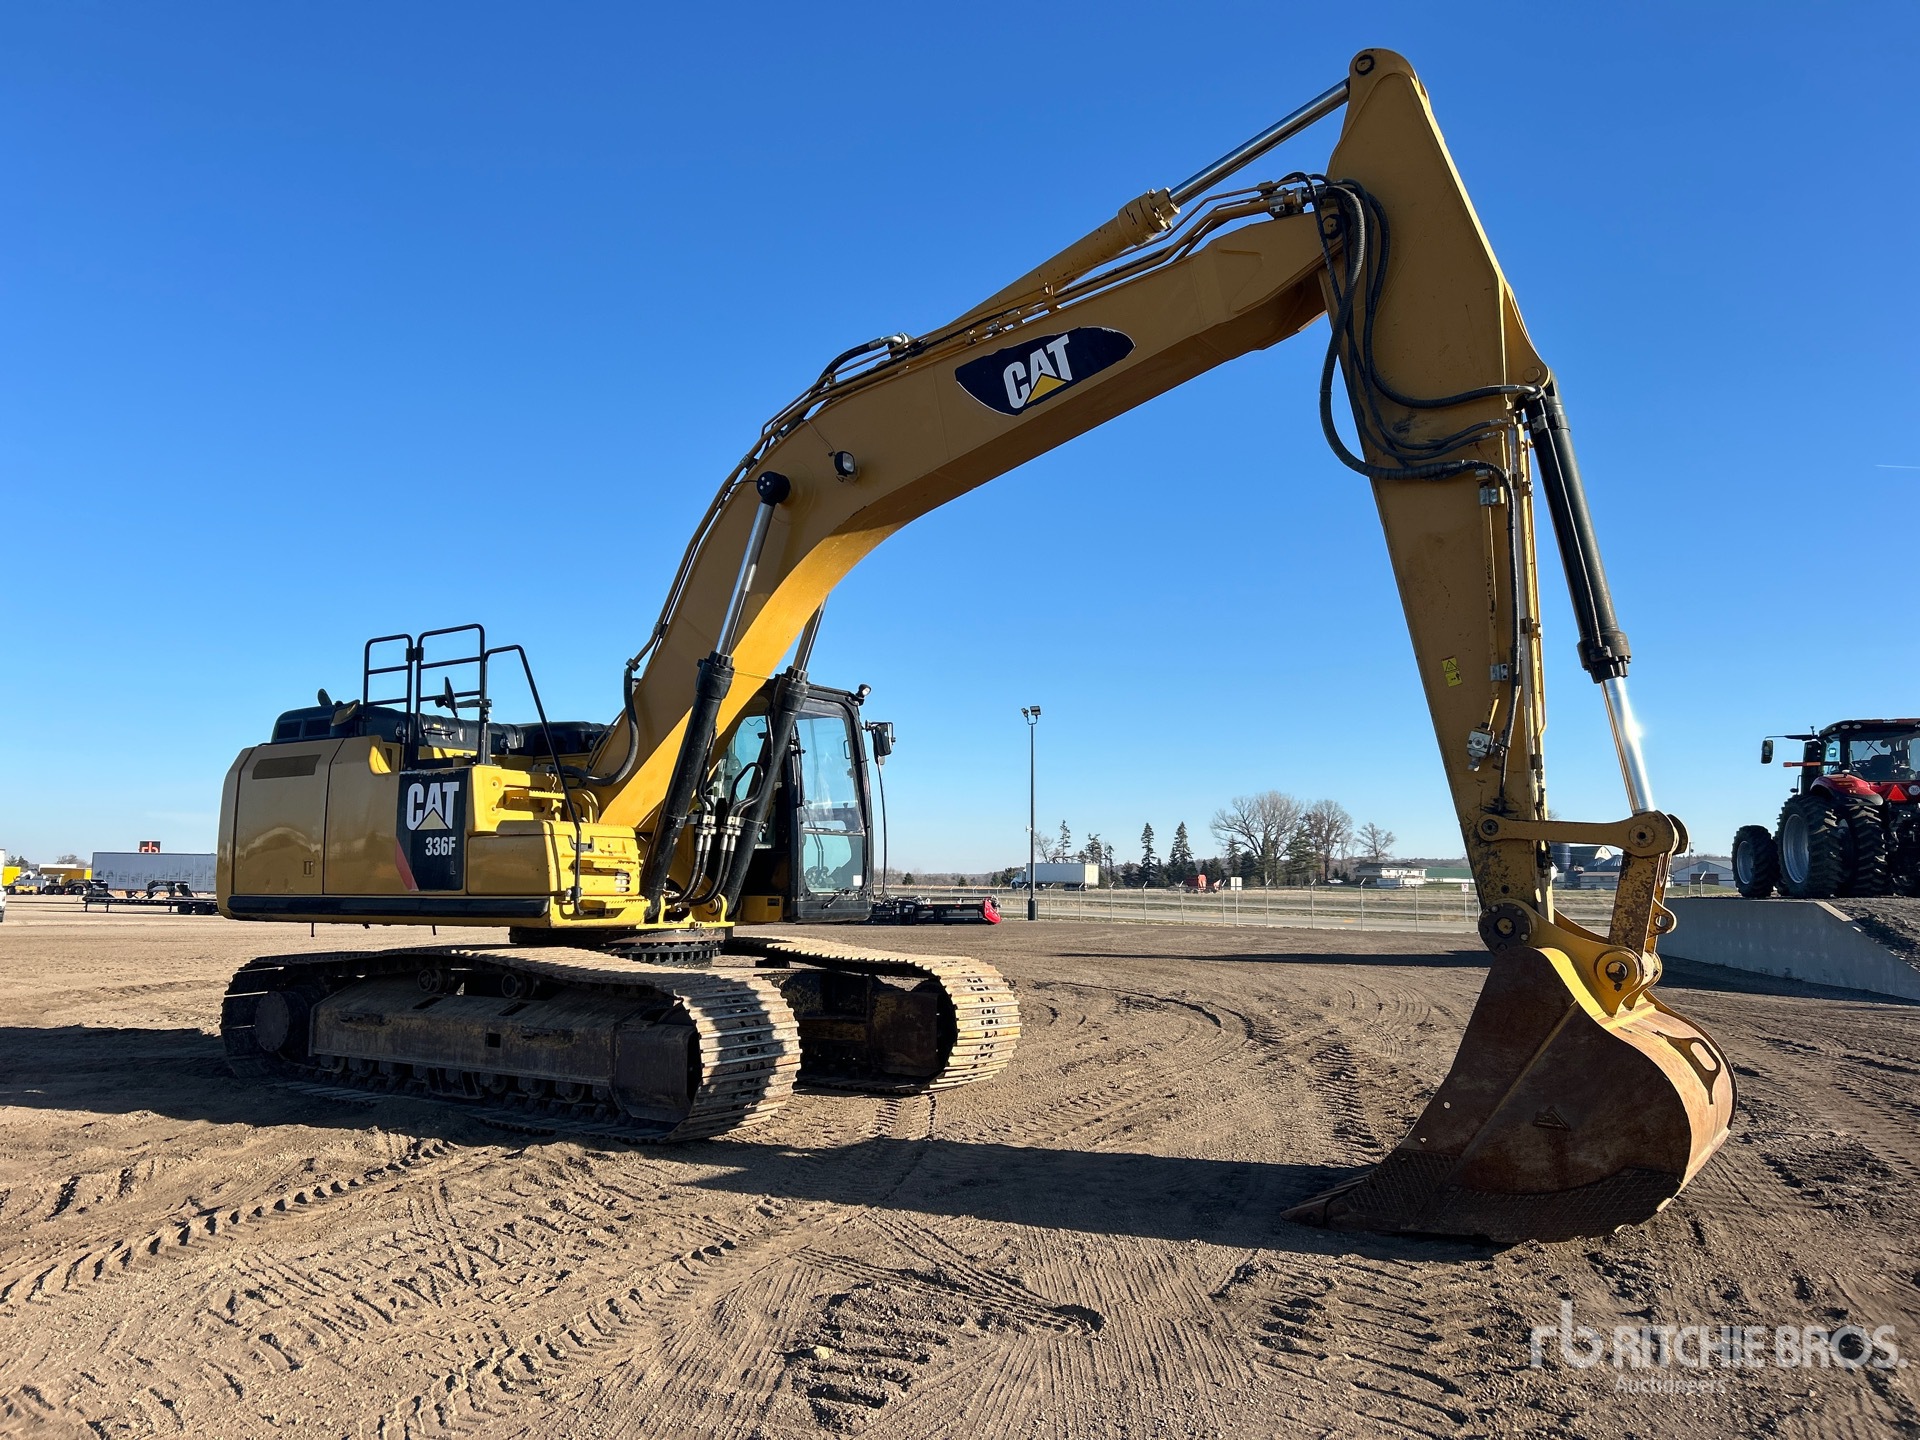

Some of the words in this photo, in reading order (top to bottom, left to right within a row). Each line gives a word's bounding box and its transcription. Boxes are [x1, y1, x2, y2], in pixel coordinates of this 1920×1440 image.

[1003, 334, 1073, 409] CAT
[406, 782, 460, 831] CAT
[425, 836, 457, 856] 336F
